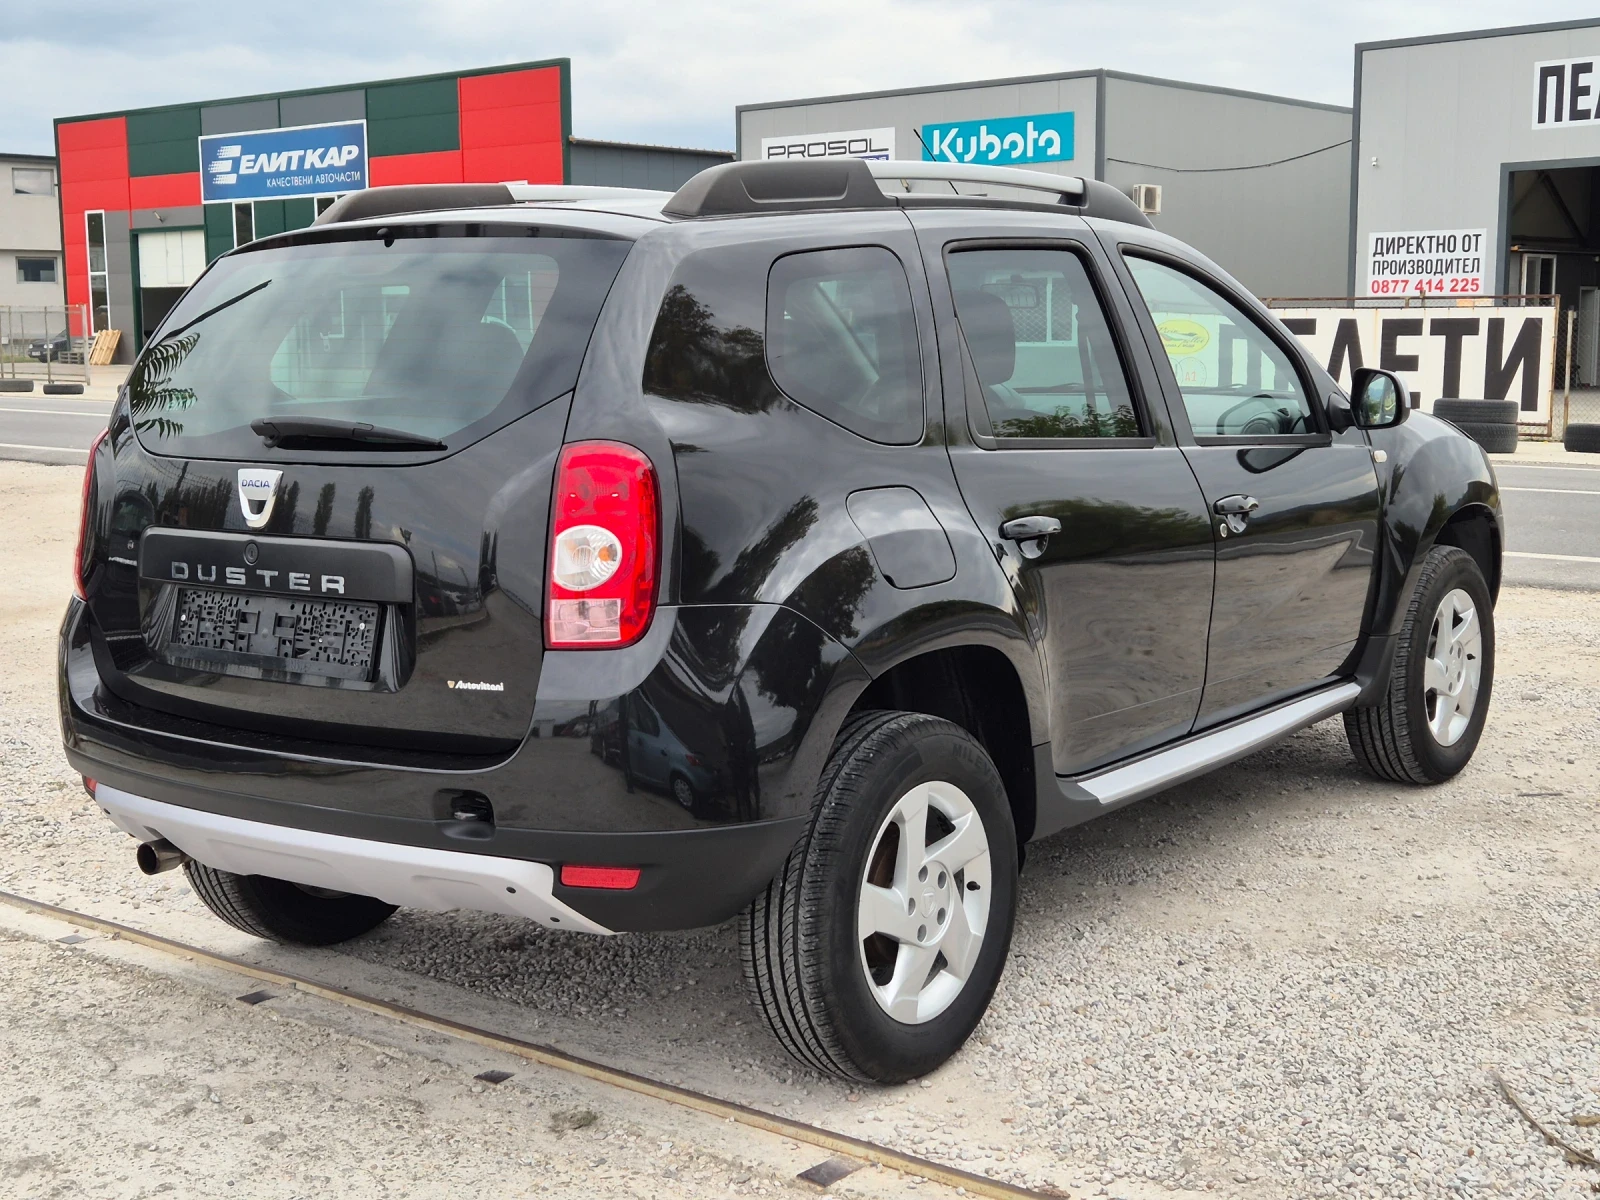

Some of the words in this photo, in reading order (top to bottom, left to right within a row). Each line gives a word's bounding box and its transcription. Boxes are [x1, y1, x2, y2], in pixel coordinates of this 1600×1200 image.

[1537, 61, 1600, 124] ПЕ
[767, 138, 890, 160] PROSOL
[933, 121, 1061, 163] Kubota
[266, 175, 314, 188] КАЧЕСТВЕНИ
[315, 171, 361, 184] АВТОЧАСТИ
[1372, 234, 1457, 257] ДИРЕКТНО
[1461, 233, 1482, 253] ОТ
[1372, 257, 1481, 276] ПРОИЗВОДИТЕЛ
[1371, 279, 1410, 294] 0877
[1414, 278, 1445, 293] 414
[1449, 277, 1480, 293] 225
[241, 479, 270, 488] DACIA
[171, 560, 346, 595] DUSTER
